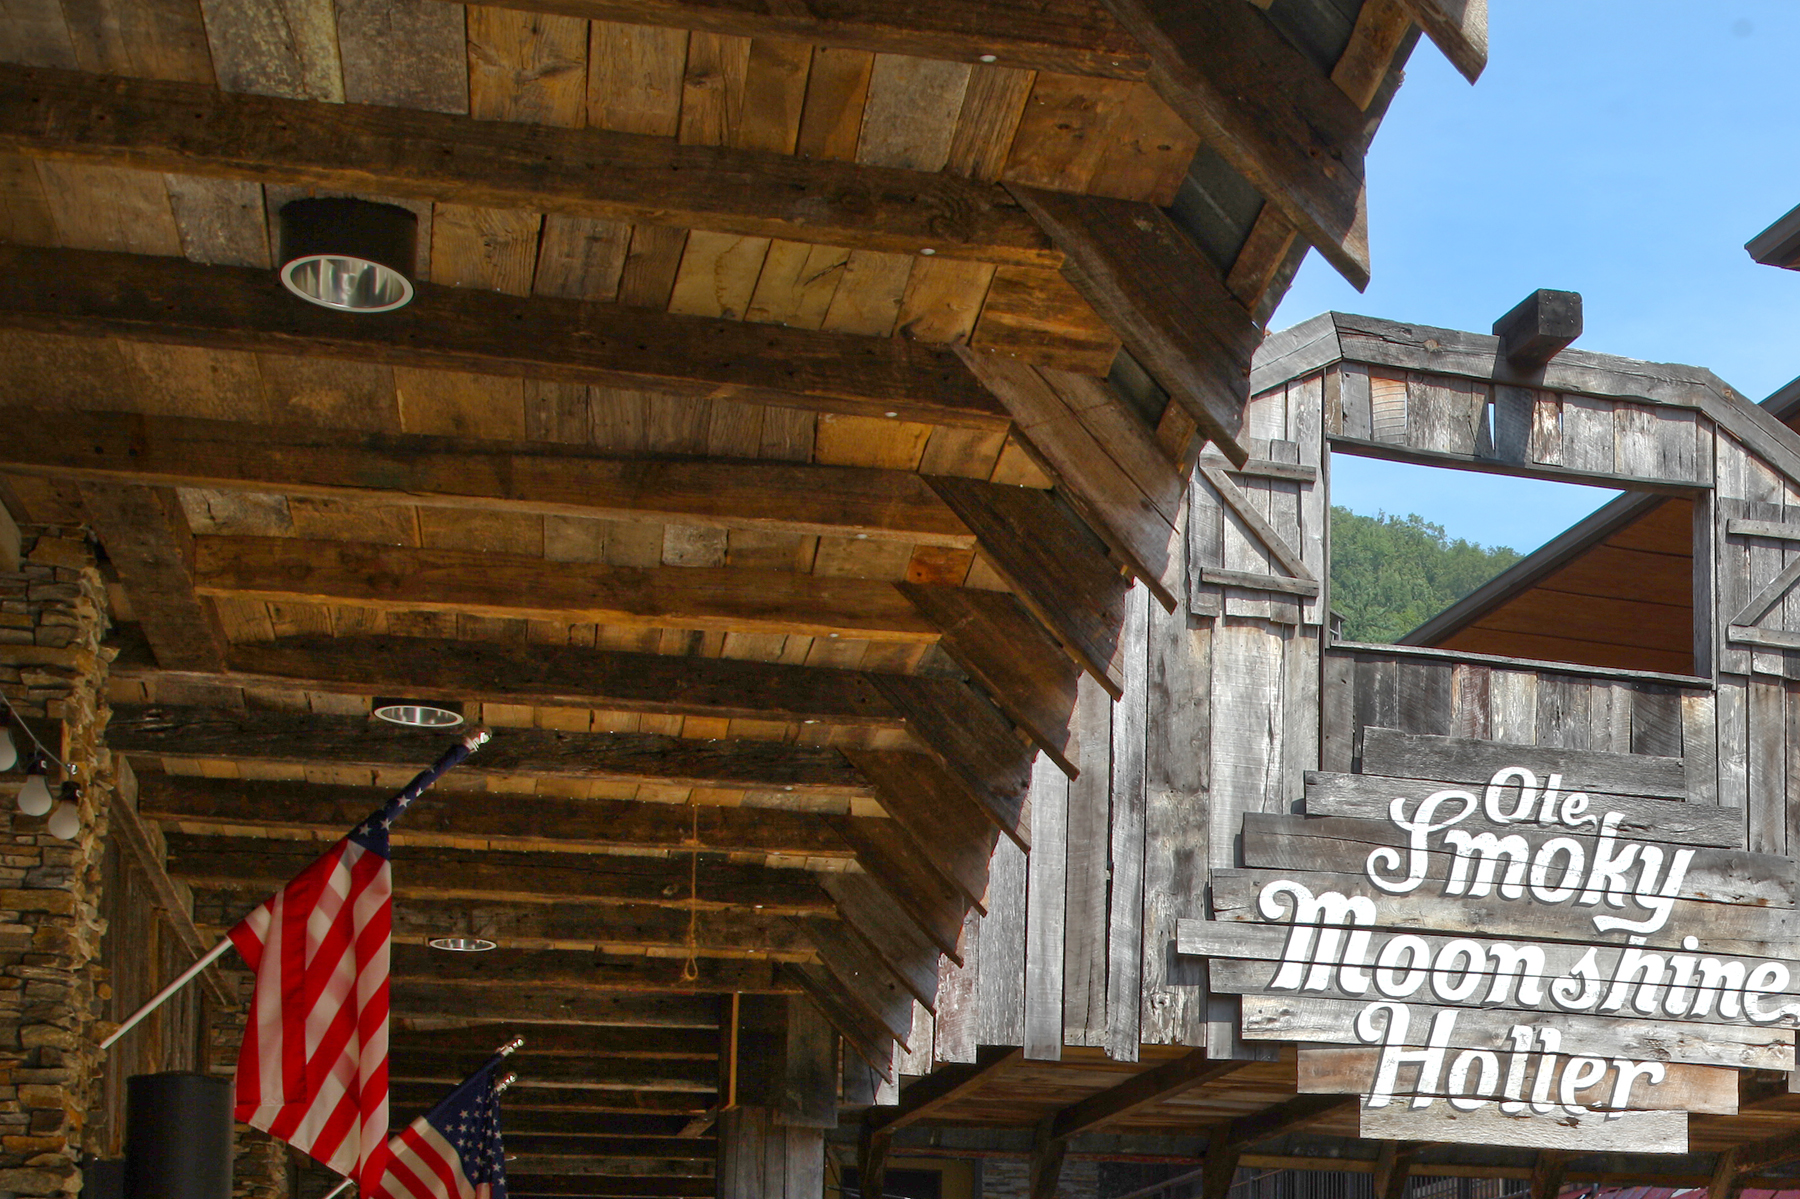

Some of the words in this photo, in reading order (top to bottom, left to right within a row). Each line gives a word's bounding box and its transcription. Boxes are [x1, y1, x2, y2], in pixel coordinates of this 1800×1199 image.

[1482, 766, 1597, 829] Ole
[1367, 789, 1695, 934] Smoky
[1355, 1001, 1665, 1121] Holler
